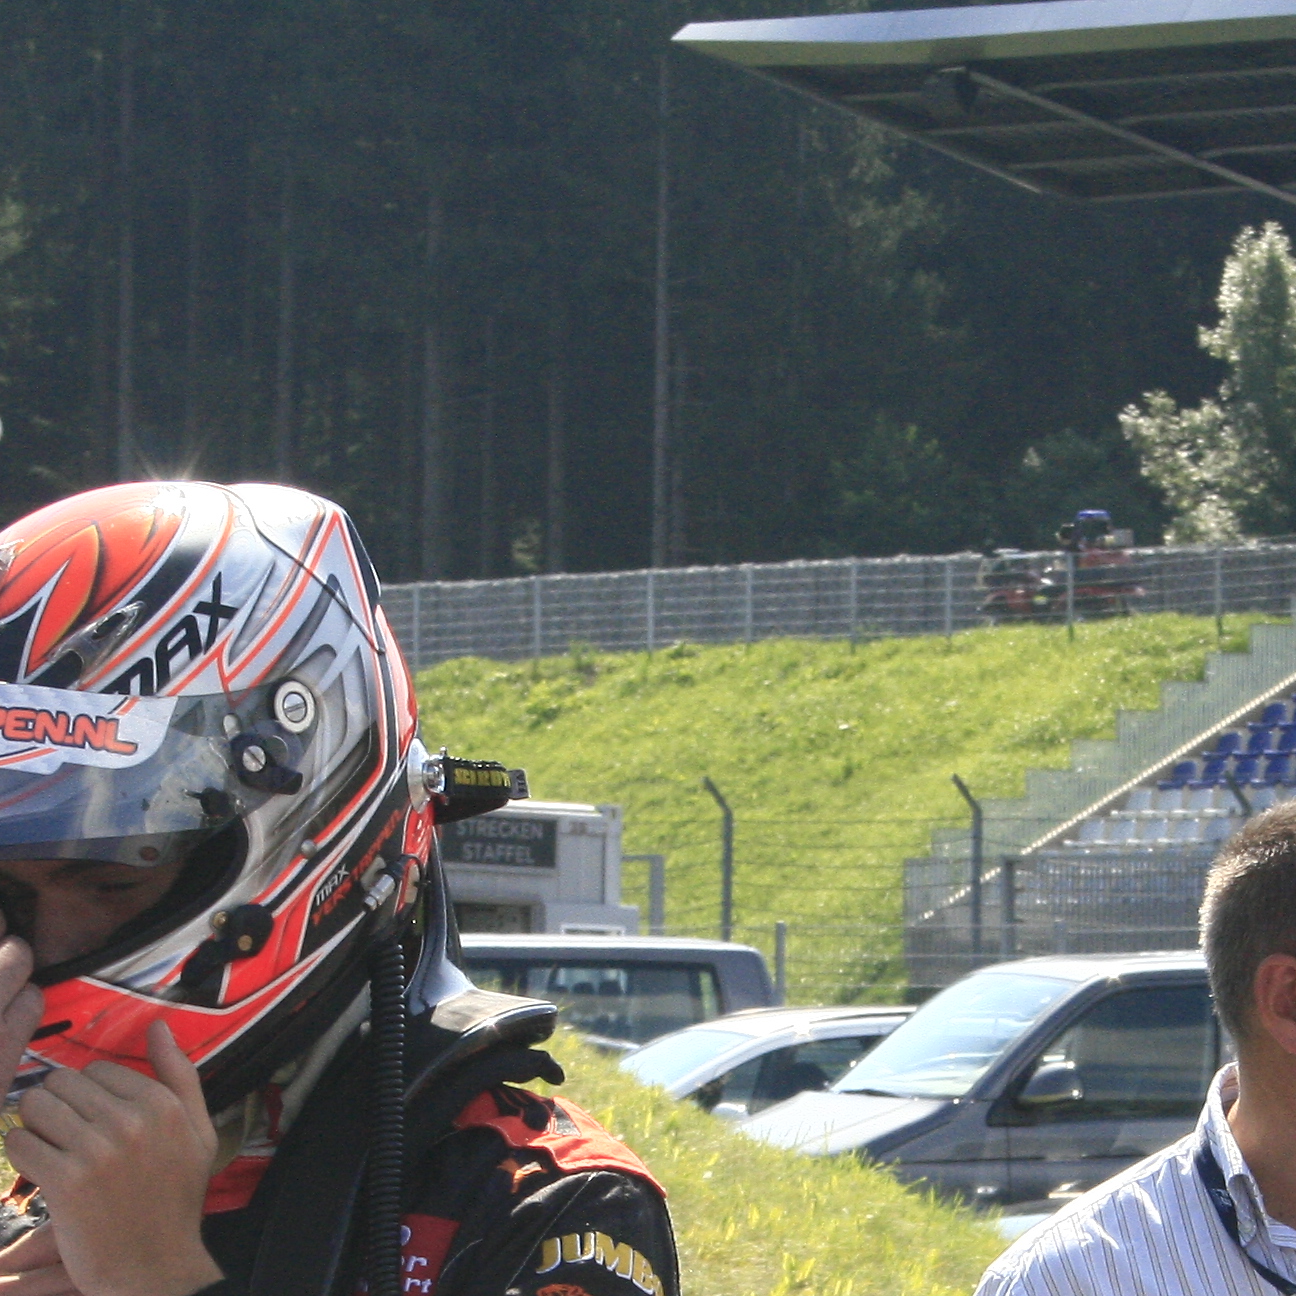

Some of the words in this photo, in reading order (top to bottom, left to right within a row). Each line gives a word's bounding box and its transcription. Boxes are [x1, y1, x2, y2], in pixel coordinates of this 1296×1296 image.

[98, 571, 239, 697] MAX
[456, 820, 544, 840] STRECKEN
[461, 843, 536, 863] STAFFEL
[316, 863, 350, 906] MAX
